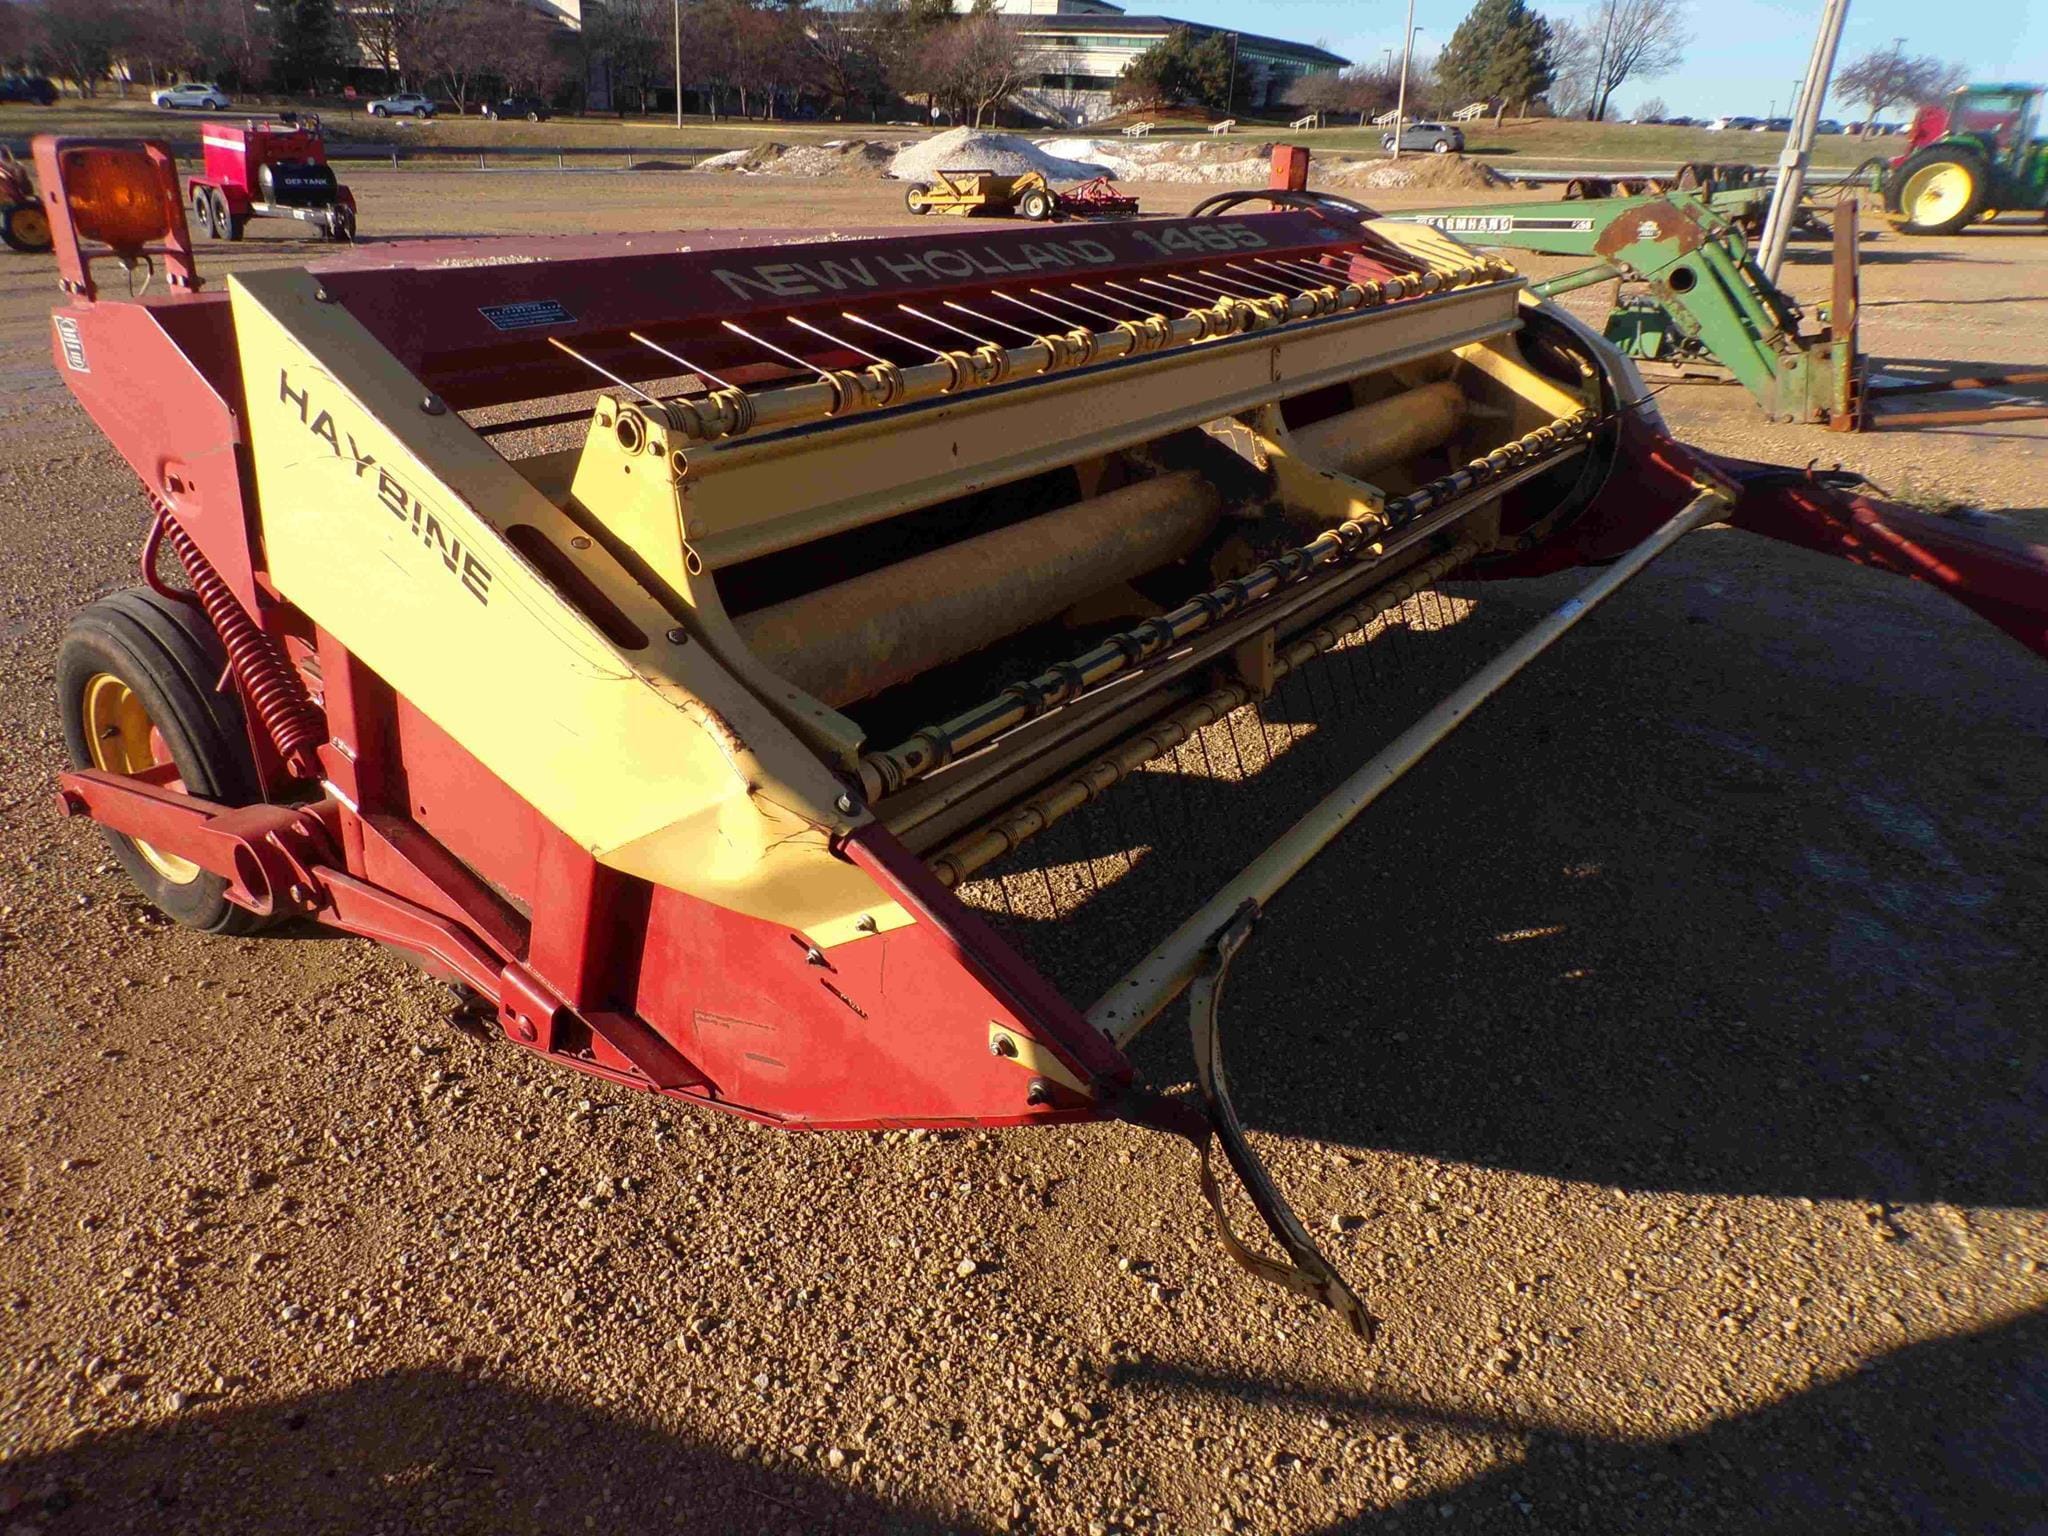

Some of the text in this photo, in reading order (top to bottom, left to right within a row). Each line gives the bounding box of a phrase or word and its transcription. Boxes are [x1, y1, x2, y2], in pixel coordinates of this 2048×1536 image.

[711, 222, 1268, 301] NEW HOLLAND 1465
[279, 367, 493, 608] HAYBINE
